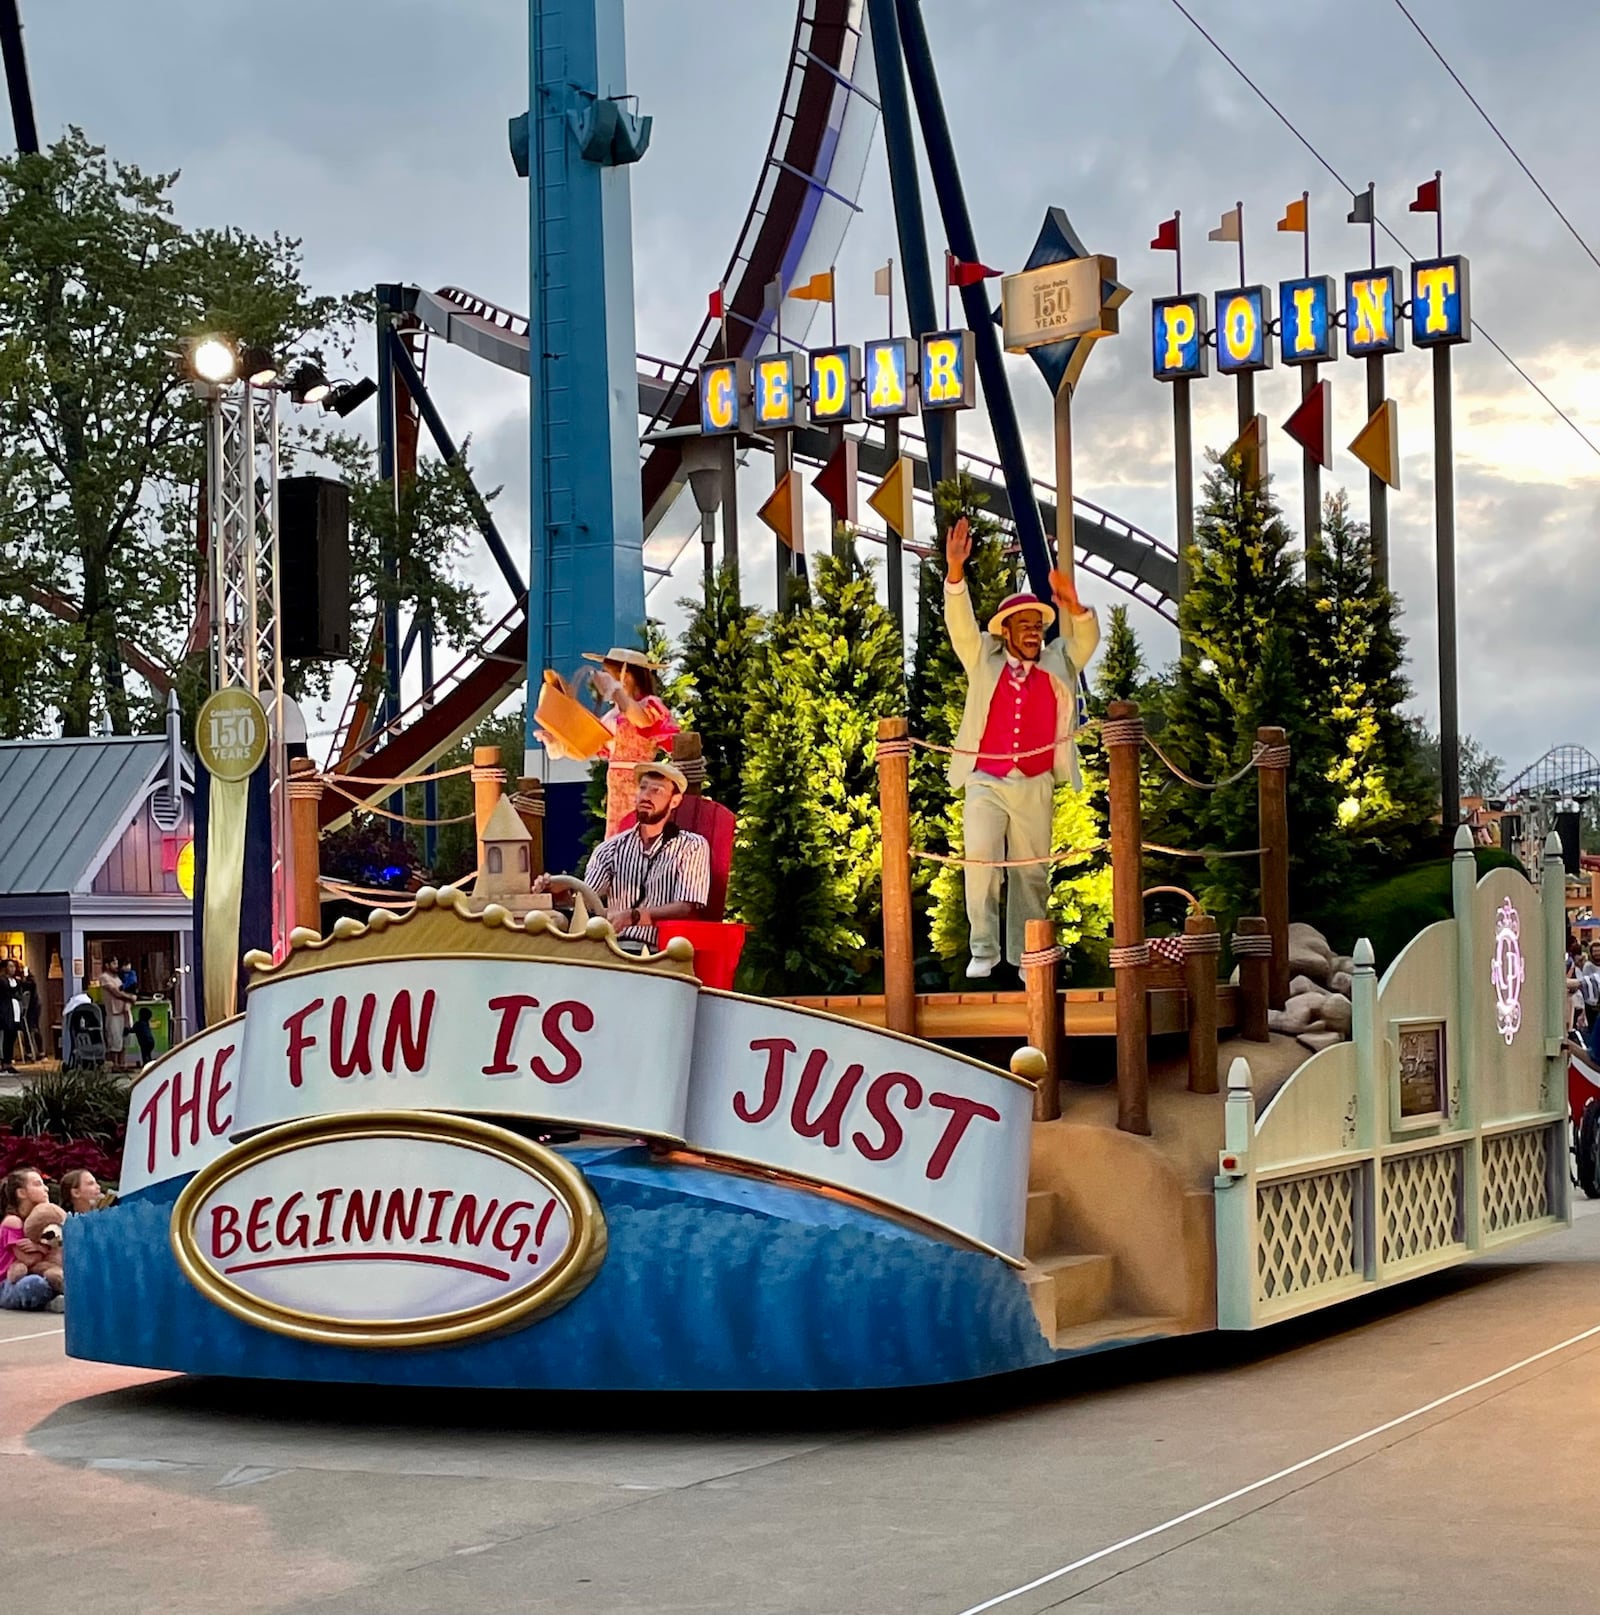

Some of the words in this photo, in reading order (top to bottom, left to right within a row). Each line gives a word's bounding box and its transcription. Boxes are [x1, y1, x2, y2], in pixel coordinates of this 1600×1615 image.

[1033, 287, 1071, 319] 150
[1035, 314, 1068, 328] YEARS
[707, 339, 961, 428] CEDAR
[1163, 266, 1456, 368] POINT
[208, 716, 256, 749] 150
[211, 748, 251, 761] YEARS
[138, 1043, 236, 1173] THE
[282, 988, 436, 1088] FUN
[482, 994, 594, 1084] IS
[732, 1038, 1001, 1180] JUST
[210, 1187, 557, 1265] BEGINNING!
